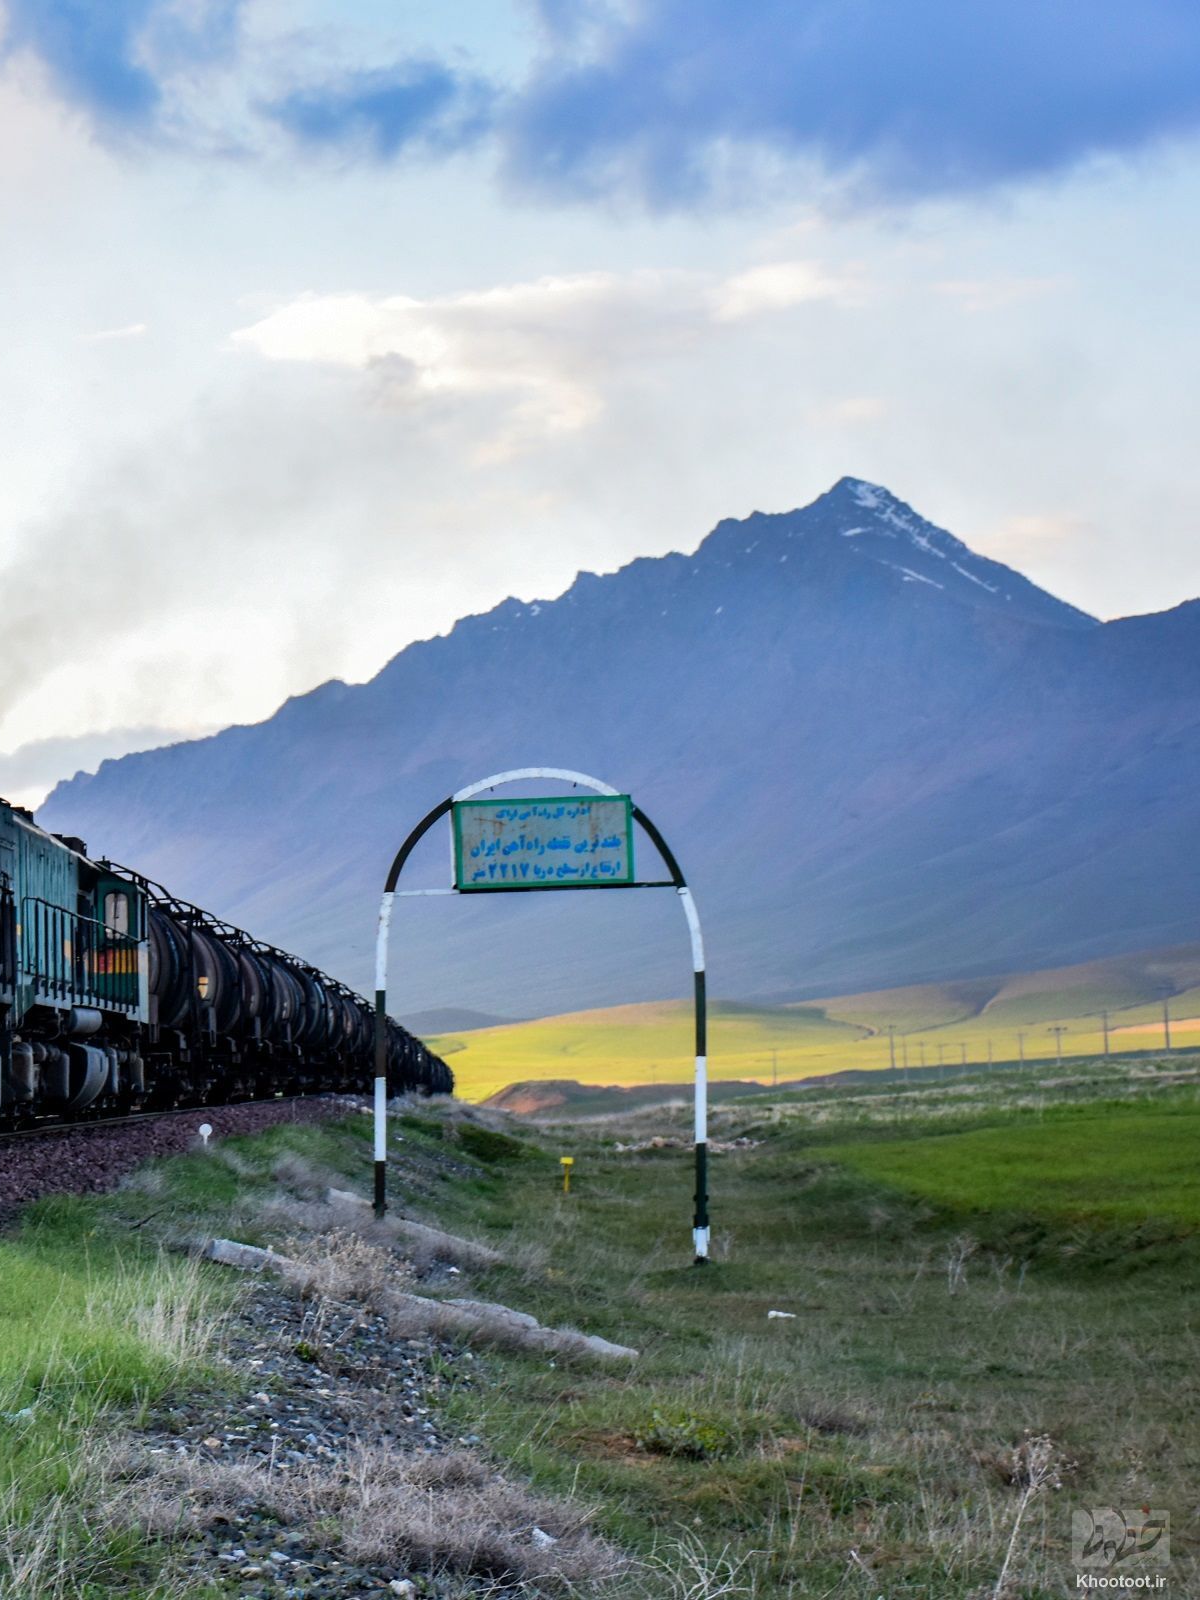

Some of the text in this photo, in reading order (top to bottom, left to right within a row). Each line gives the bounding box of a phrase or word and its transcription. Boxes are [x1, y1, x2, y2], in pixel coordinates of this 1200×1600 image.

[470, 837, 501, 858] ایران
[502, 834, 526, 855] آهن
[526, 837, 546, 855] راه
[533, 863, 554, 880] دریا
[556, 863, 579, 878] سطح
[590, 860, 621, 878] ارتفاع
